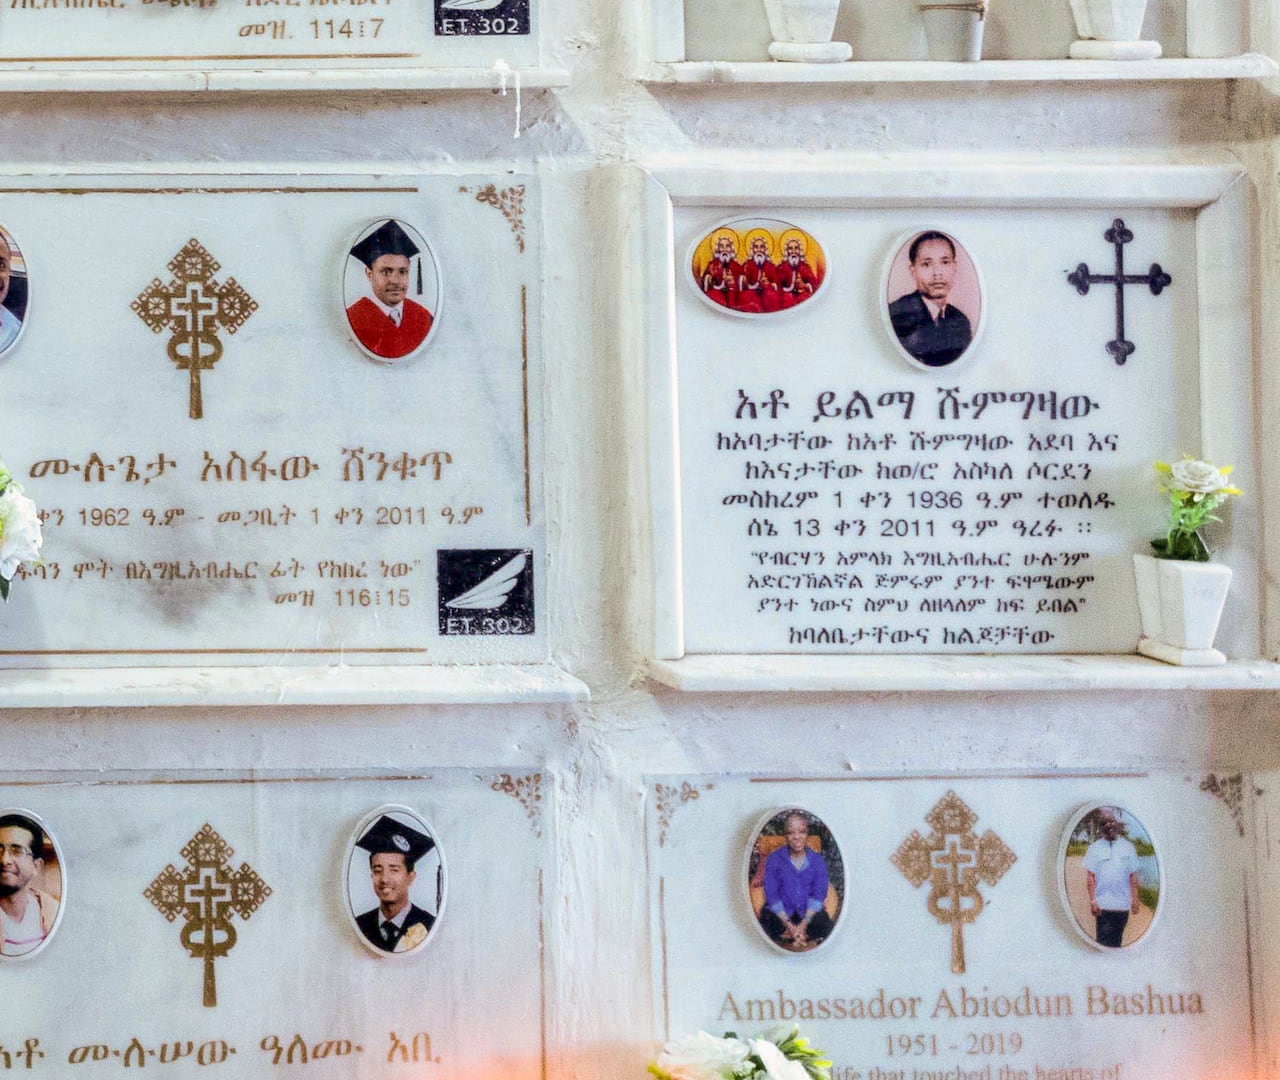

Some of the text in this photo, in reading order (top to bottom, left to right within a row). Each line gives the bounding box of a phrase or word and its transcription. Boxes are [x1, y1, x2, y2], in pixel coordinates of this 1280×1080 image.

[441, 18, 520, 34] ET 302
[735, 386, 1100, 423] አቶ ይልማ ሹምግዛው
[716, 430, 833, 452] ከአባታቸው
[846, 432, 897, 451] ከአቶ
[909, 430, 1014, 452] ሹምግዛው
[1087, 432, 1119, 452] እና
[28, 446, 453, 486] ሙሉጌታ አስፋው ሽንቁጥ
[745, 459, 863, 481] ከእናታቸው
[876, 461, 939, 481] ከወ/ሮ
[953, 461, 1014, 480] አስካለ
[721, 489, 1116, 510] መስከረም 1 ቀን 1936 ዓ.ም ተወለዱ
[793, 518, 821, 538] 13
[833, 519, 867, 537] ቀን
[880, 518, 935, 538] 2011
[951, 519, 999, 537] ዓ.ም
[1012, 518, 1063, 538] ዓረፉ
[836, 551, 893, 566] አምላክ
[903, 550, 1012, 568] እግዚአብሔር
[1023, 552, 1091, 567] ሁሉንም
[789, 625, 1056, 645] ከባለቤታቸውና ከልጆቻቸው
[716, 985, 1205, 1021] Ambassador Abiodun Bashua
[260, 1033, 363, 1065] ዓለሙ
[886, 1032, 1024, 1057] 1951 2019
